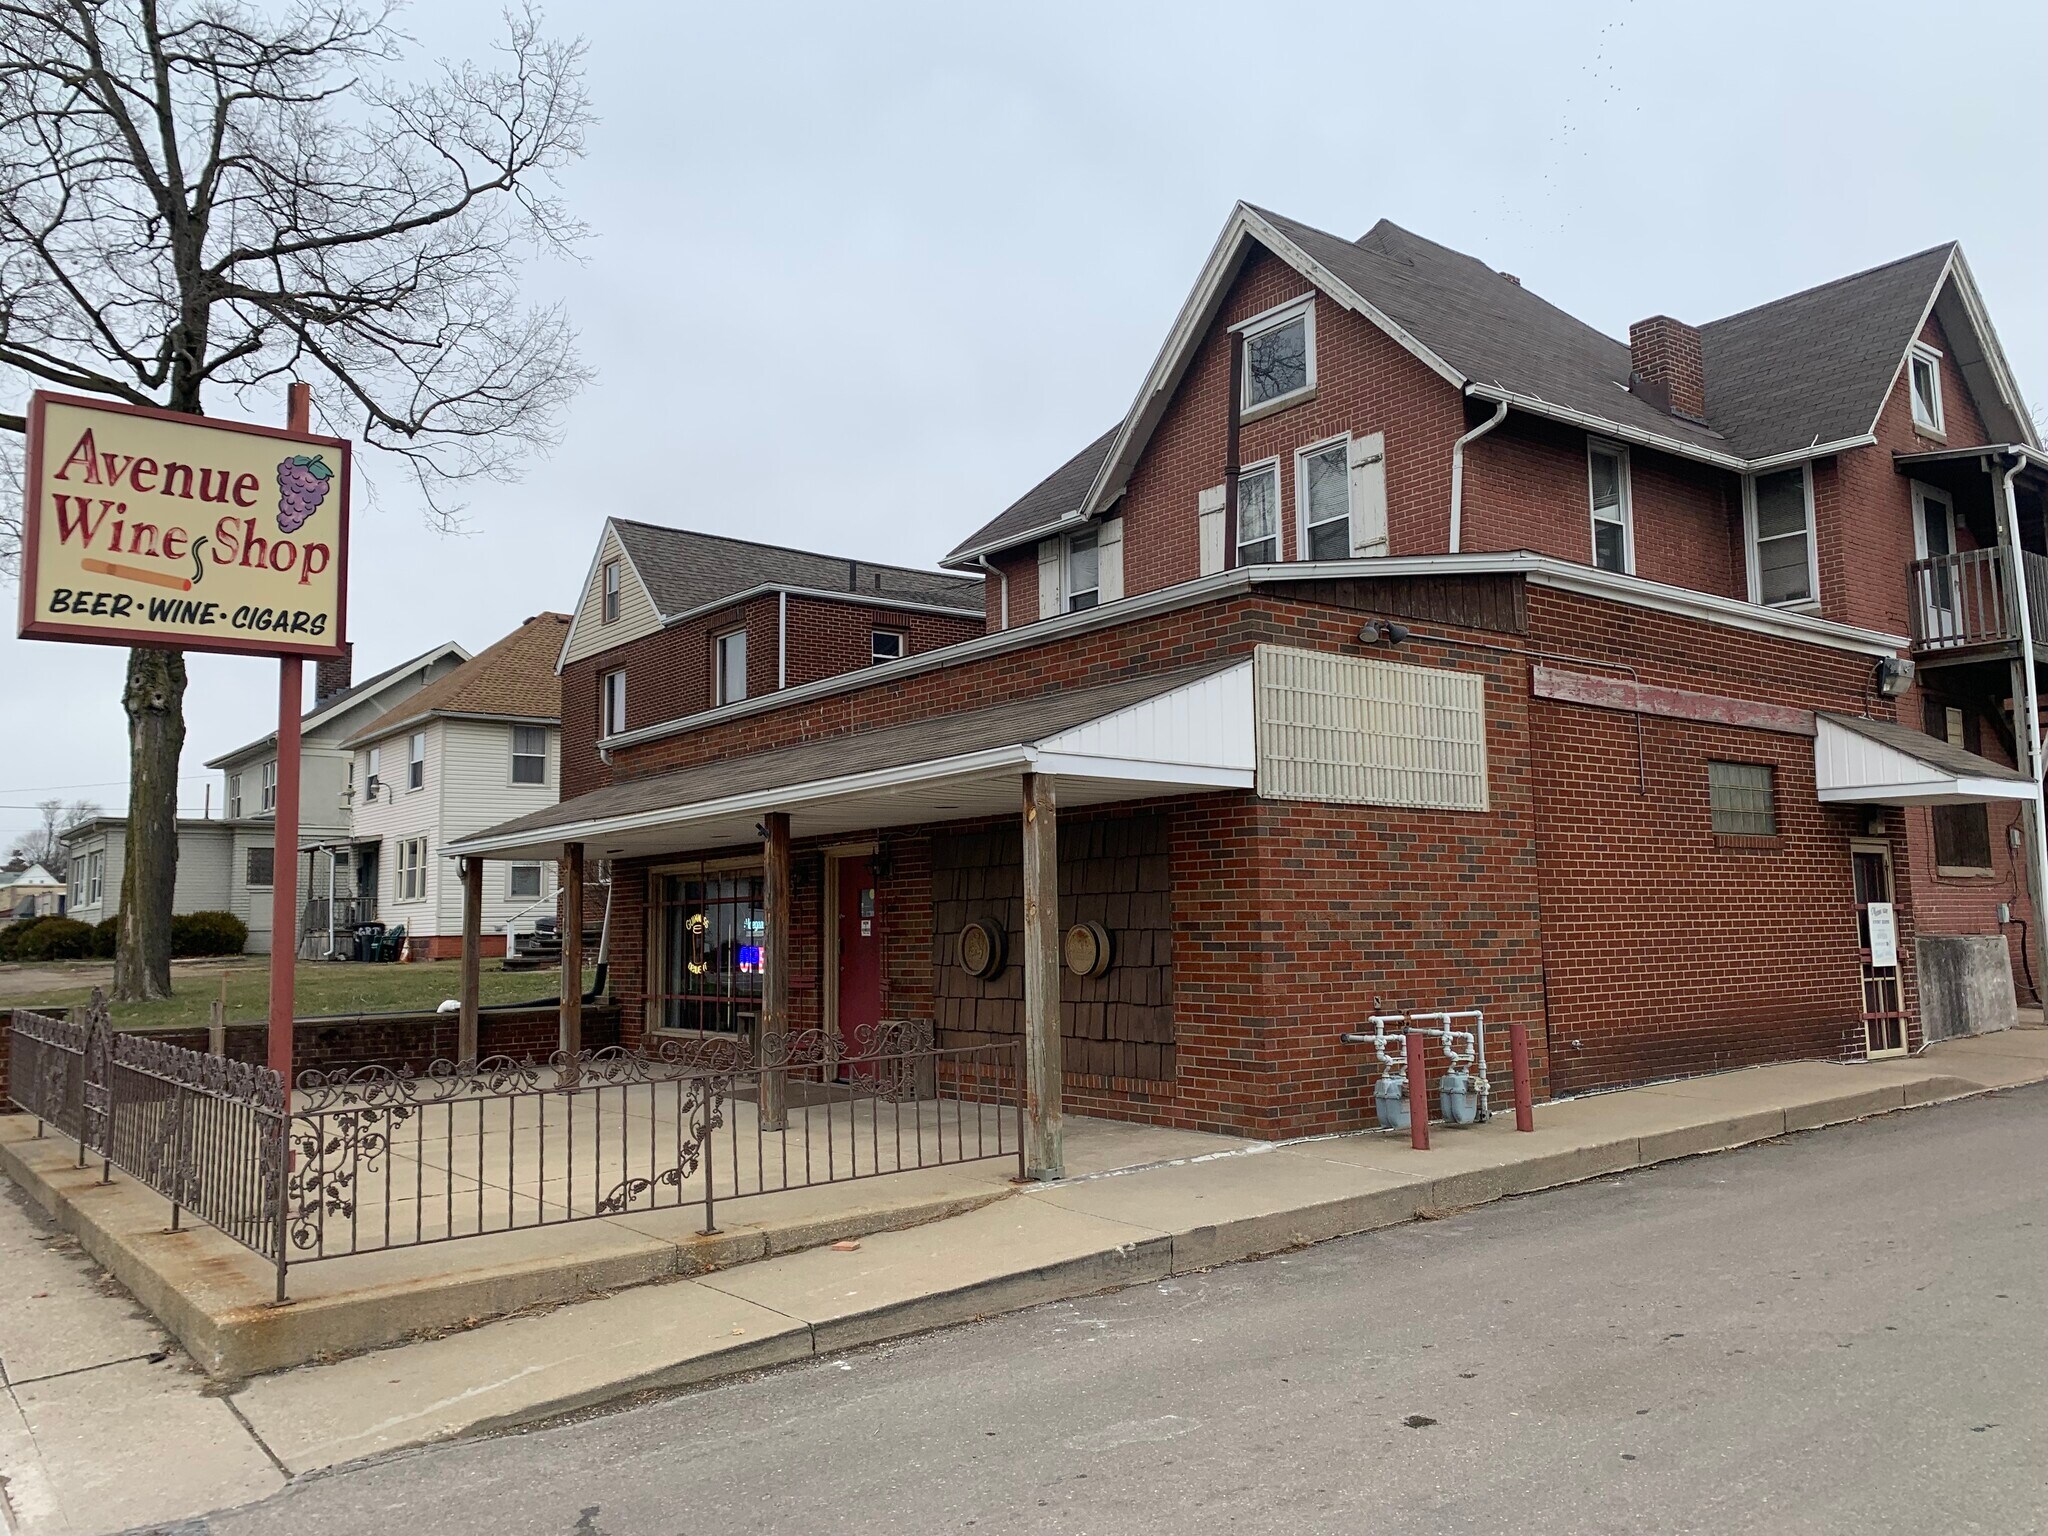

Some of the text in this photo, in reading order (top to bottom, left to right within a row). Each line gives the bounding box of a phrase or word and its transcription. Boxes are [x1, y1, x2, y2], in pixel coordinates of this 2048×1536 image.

[54, 427, 260, 508] Avenue
[52, 493, 331, 585] Wine Shop
[49, 588, 328, 636] BEER WINE CIGARS
[686, 914, 709, 930] GUINNSS
[740, 946, 764, 974] OPE
